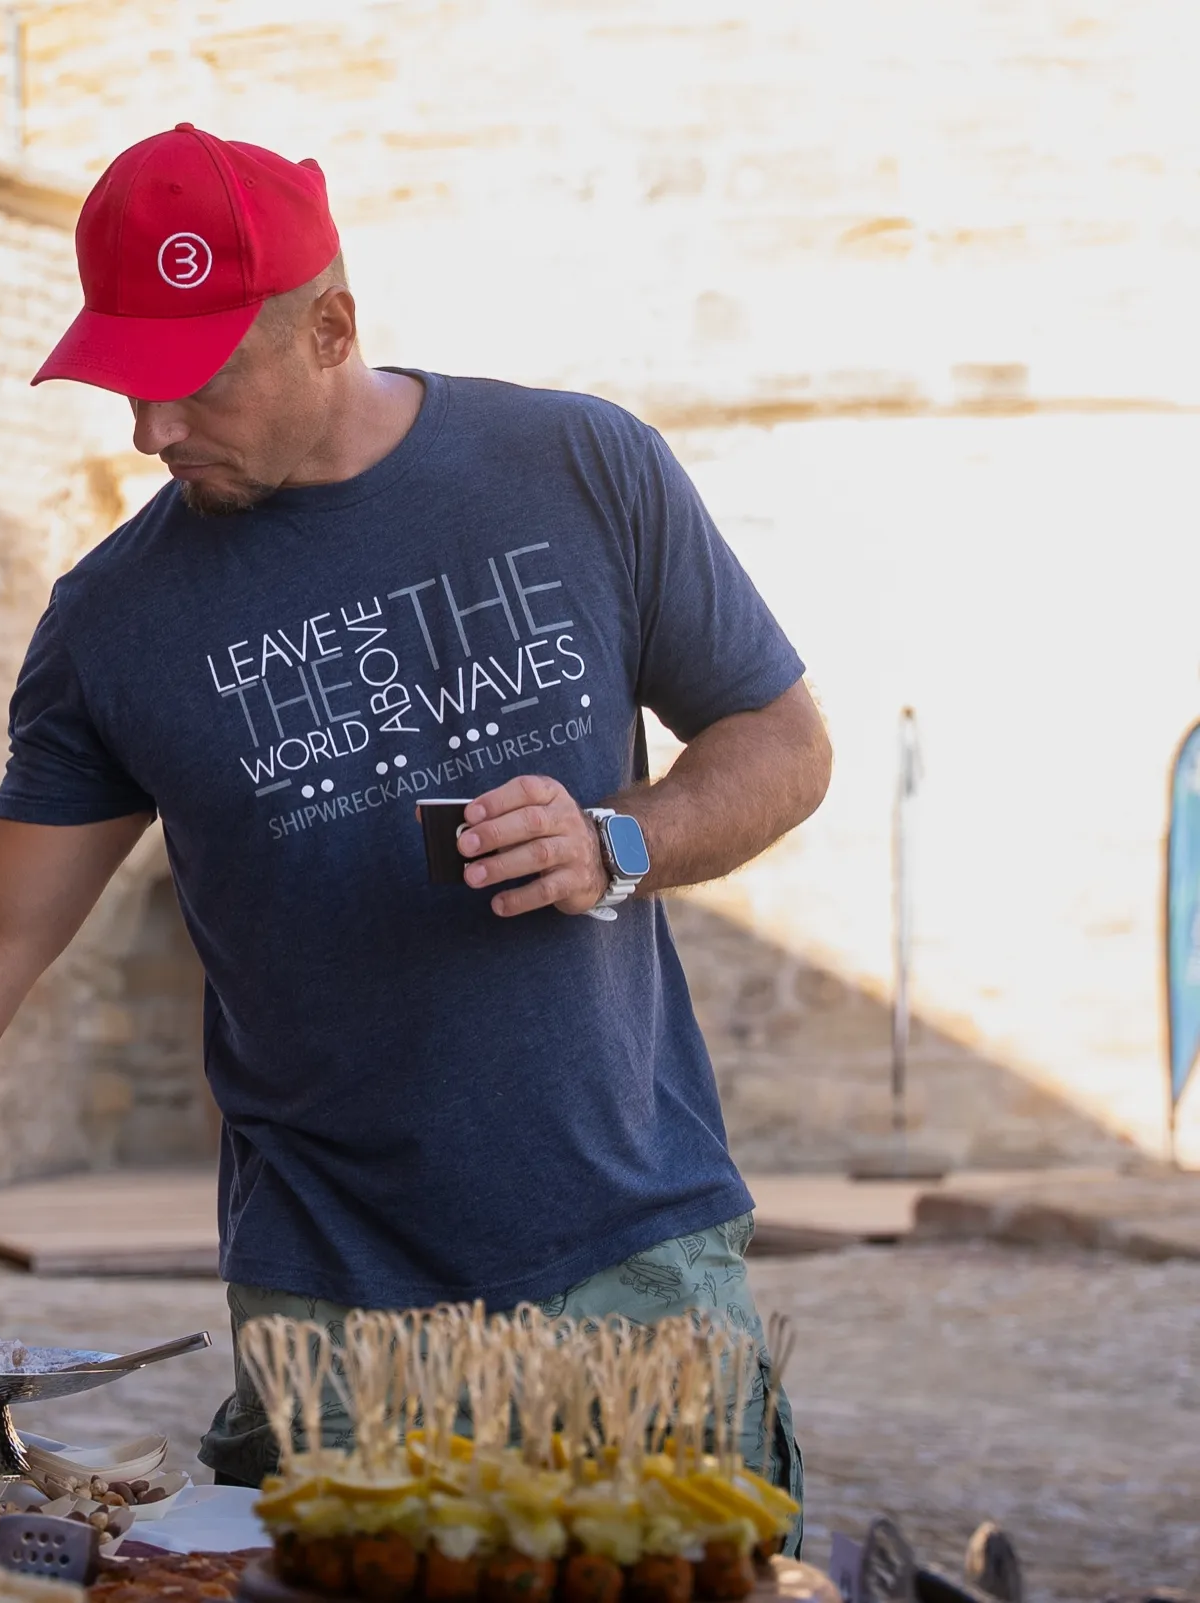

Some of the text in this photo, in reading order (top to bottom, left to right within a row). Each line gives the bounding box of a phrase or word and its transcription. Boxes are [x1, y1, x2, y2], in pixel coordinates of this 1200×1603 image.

[174, 242, 198, 279] 3
[207, 612, 342, 693] LEAVE
[387, 541, 574, 671] THE
[220, 651, 362, 748] THE
[341, 596, 420, 733] ABOVE
[415, 634, 585, 724] WAVES
[240, 720, 370, 785] WORLD
[268, 715, 593, 840] SHIPWRECKADVENTURES.COM
